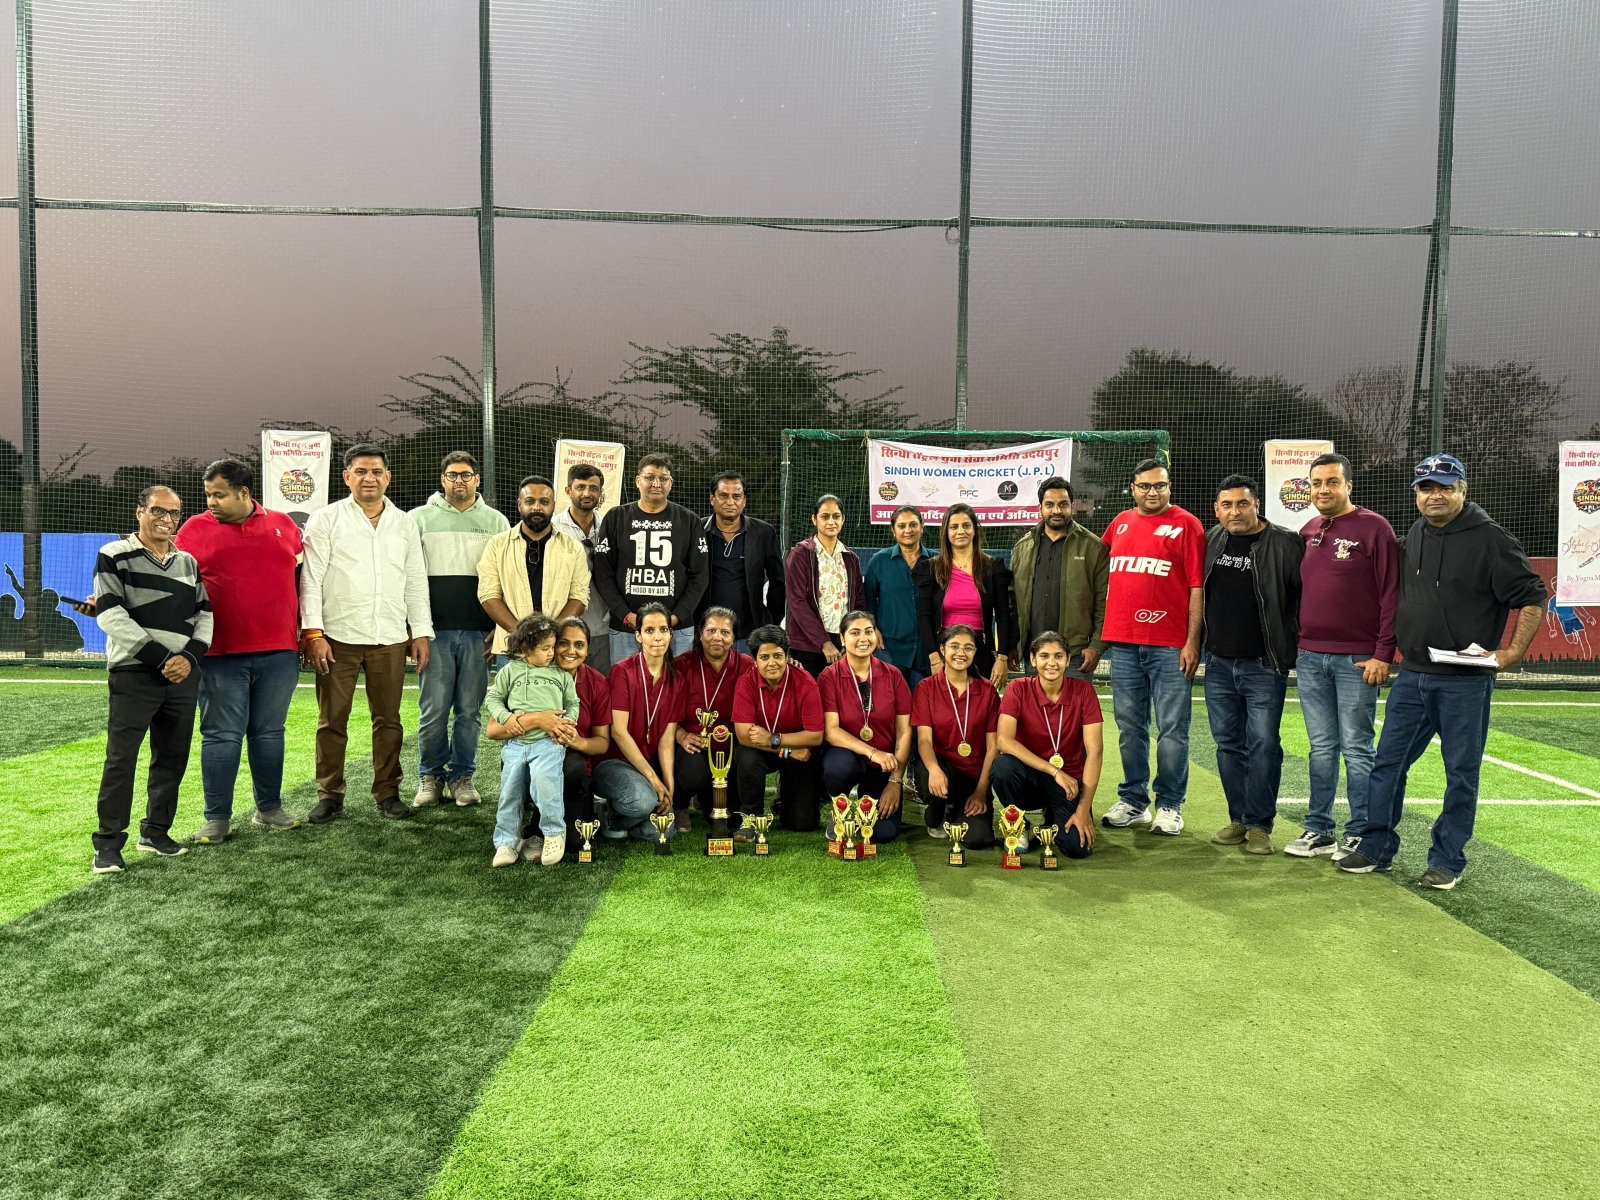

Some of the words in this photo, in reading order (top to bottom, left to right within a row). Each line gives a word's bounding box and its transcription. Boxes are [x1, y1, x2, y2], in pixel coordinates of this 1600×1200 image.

[884, 466, 920, 476] SINDHI
[923, 468, 966, 477] WOMEN
[968, 468, 1015, 477] CRICKET
[629, 530, 672, 567] 15
[1110, 556, 1172, 576] UTURE
[632, 568, 668, 584] HBA
[633, 586, 646, 594] HOOD
